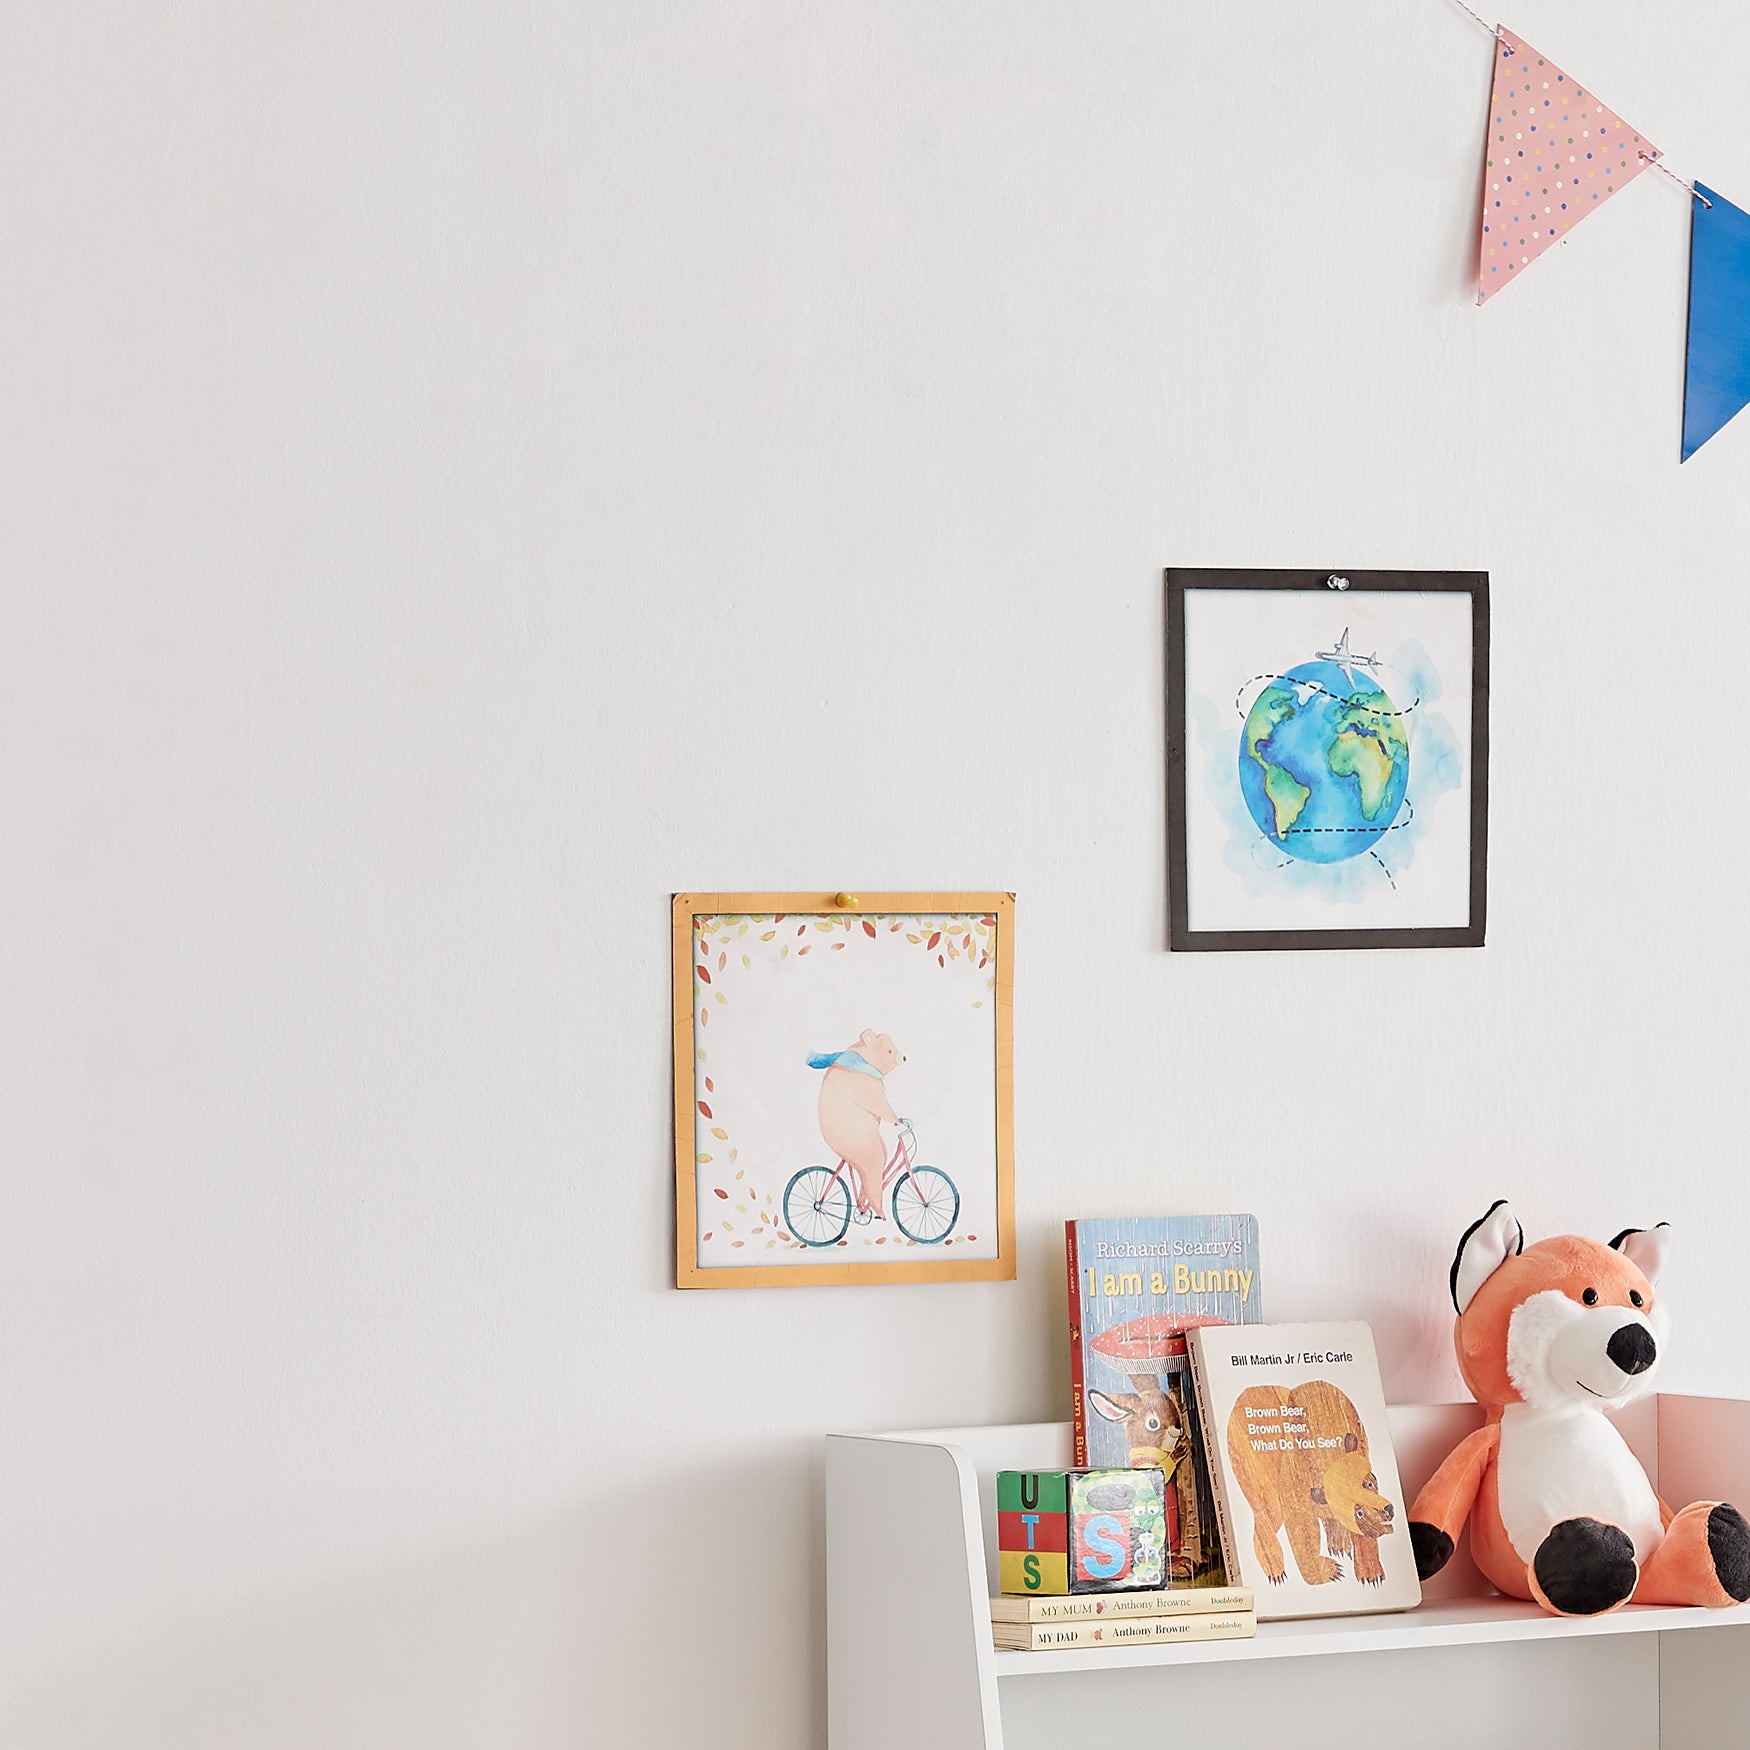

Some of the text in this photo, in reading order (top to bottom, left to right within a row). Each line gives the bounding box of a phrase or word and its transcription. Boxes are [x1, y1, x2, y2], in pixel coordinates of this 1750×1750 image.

[1096, 1237, 1242, 1258] Richard Scarry's
[1088, 1263, 1254, 1302] I am a Bunny
[1231, 1355, 1248, 1366] Bill
[1250, 1354, 1282, 1366] Martin
[1285, 1353, 1295, 1364] Jr
[1303, 1352, 1324, 1364] Eric
[1326, 1351, 1353, 1363] Carle
[1074, 1391, 1081, 1417] am
[1245, 1405, 1307, 1418] Brown Bear,
[1075, 1422, 1082, 1432] a
[1248, 1422, 1310, 1435] Brown Bear,
[1250, 1436, 1342, 1451] What Do You See?
[1021, 1474, 1039, 1509] U
[1021, 1514, 1039, 1549] T
[1083, 1515, 1125, 1578] S
[1023, 1554, 1041, 1590] S
[1041, 1604, 1059, 1616] MY
[1062, 1603, 1093, 1615] MUM
[1113, 1600, 1153, 1613] Anthony
[1156, 1597, 1192, 1608] Browne
[1038, 1632, 1054, 1644] MY
[1056, 1631, 1079, 1643] DAD
[1112, 1625, 1152, 1638] Anthony
[1155, 1624, 1191, 1634] Browne
